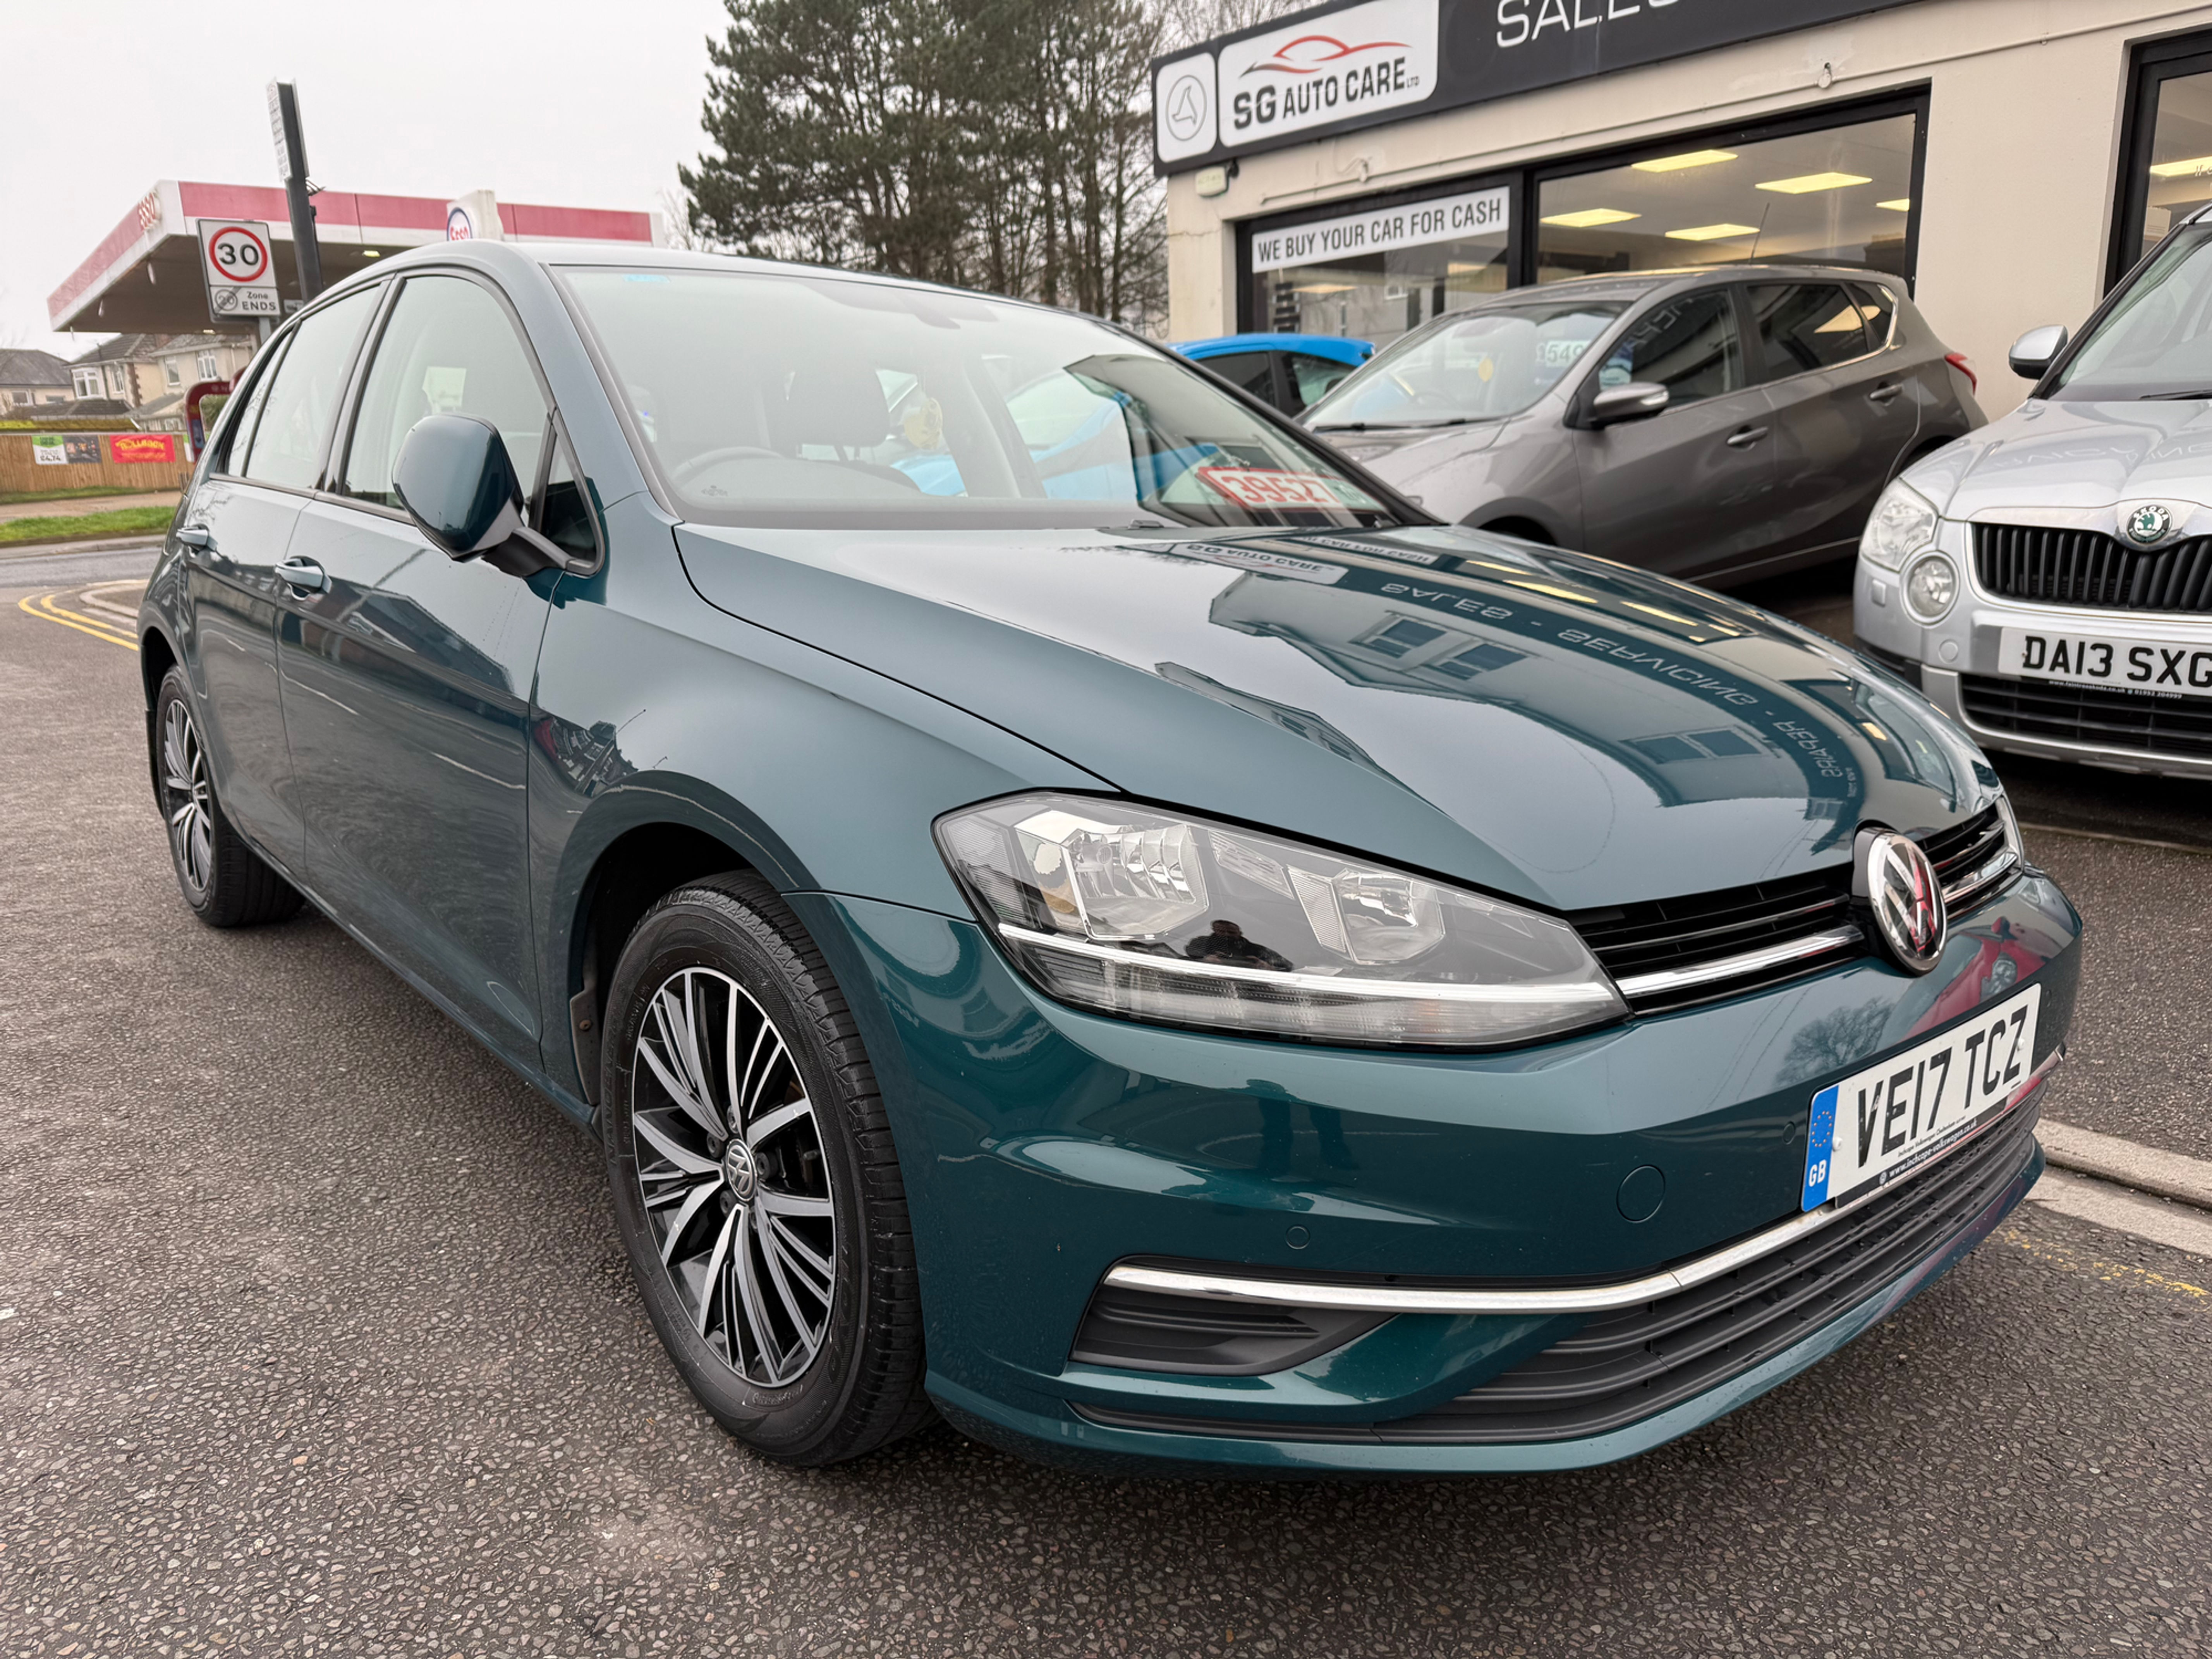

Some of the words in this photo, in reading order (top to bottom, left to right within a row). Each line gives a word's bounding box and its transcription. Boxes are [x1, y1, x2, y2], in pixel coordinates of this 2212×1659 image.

[1497, 0, 1679, 47] SAL
[1234, 85, 1276, 130] SG
[1283, 75, 1338, 118] AUTO
[1345, 57, 1405, 102] CARE
[1407, 76, 1420, 88] LTD
[1258, 239, 1281, 262] WE
[1285, 235, 1316, 258] BUY
[1321, 224, 1364, 251] YOUR
[1371, 217, 1403, 242] CAR
[1411, 209, 1444, 235] FOR
[1452, 198, 1501, 229] CASH
[218, 243, 259, 265] 30
[242, 301, 276, 310] ENDS
[1221, 476, 1341, 503] 39527
[2022, 635, 2114, 677] DA13
[2126, 647, 2212, 688] SXG
[1858, 1047, 1952, 1168] VE17
[1964, 1004, 2028, 1109] TCZ
[1808, 1159, 1826, 1187] GB
